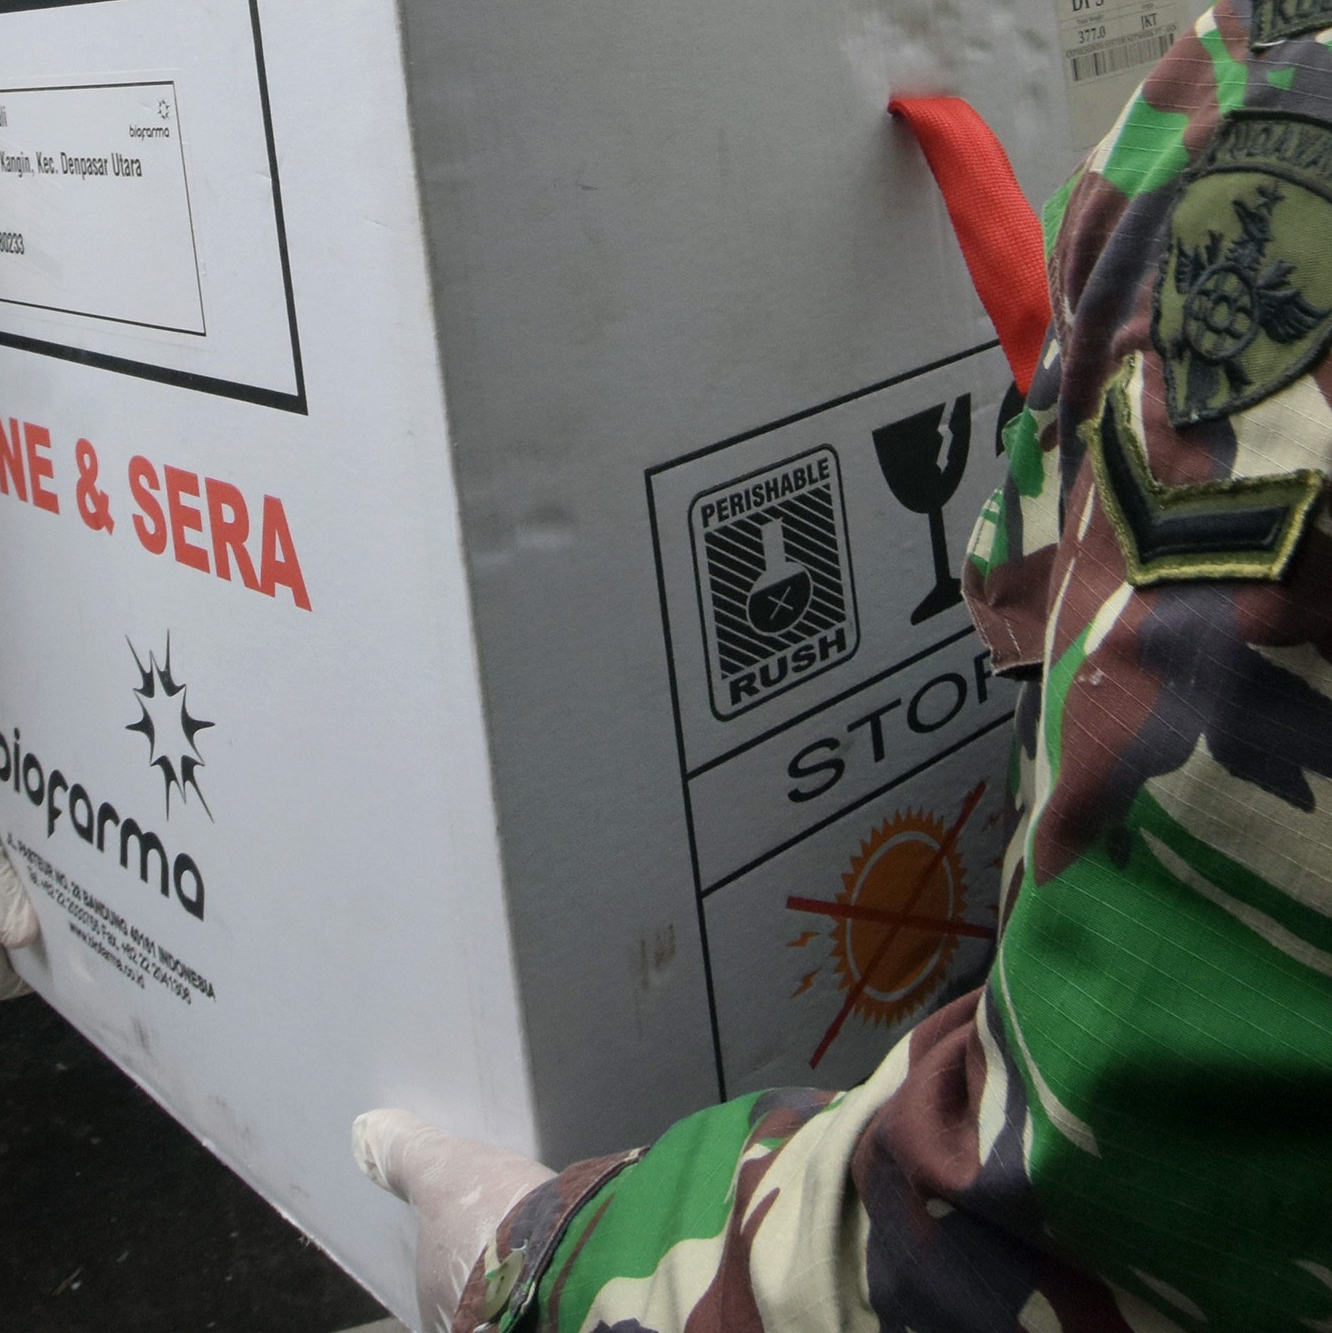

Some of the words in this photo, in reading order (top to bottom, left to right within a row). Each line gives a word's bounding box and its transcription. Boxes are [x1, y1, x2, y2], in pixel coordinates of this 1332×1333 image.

[1078, 26, 1107, 44] 377.0
[129, 124, 171, 141] biofarma
[36, 151, 59, 174] Kec.
[61, 152, 109, 180] Denpasar
[111, 152, 143, 177] Utara
[701, 456, 831, 530] PERISHABLE
[74, 437, 115, 536] &
[127, 454, 313, 613] SERA
[728, 627, 848, 706] RUSH
